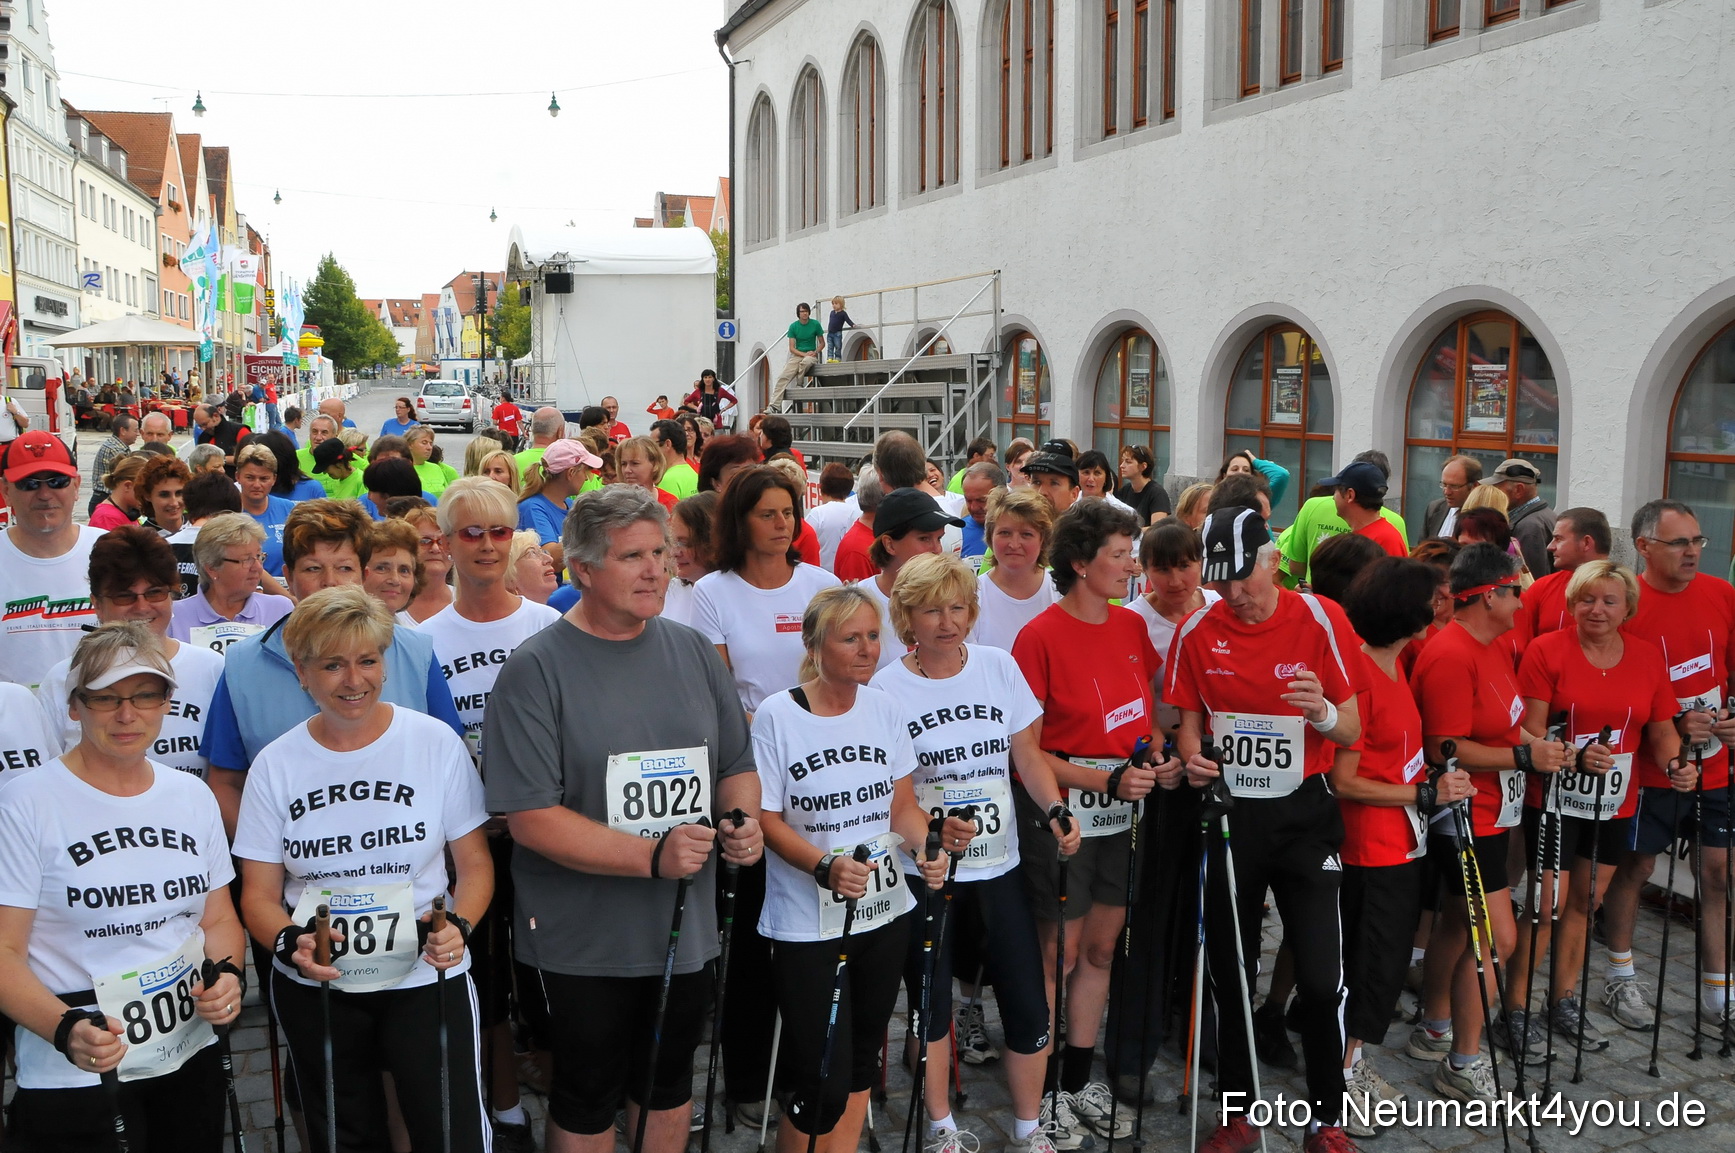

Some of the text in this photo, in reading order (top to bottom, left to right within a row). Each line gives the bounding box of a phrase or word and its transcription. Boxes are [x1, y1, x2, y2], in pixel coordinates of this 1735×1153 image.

[265, 289, 275, 337] HOTEL
[1682, 661, 1699, 674] DEHN
[907, 703, 1004, 739] BERGER
[1114, 707, 1134, 723] DEHN
[1235, 719, 1273, 730] BOCK
[788, 744, 887, 782] BERGER
[916, 745, 968, 768] OWER
[1222, 734, 1293, 769] 8055
[641, 756, 686, 771] BOCK
[1235, 773, 1271, 789] Horst
[288, 780, 415, 822] BERGER
[622, 775, 703, 821] 8022
[790, 790, 851, 813] POWER
[943, 788, 983, 800] BOCK
[804, 822, 841, 834] walking
[843, 815, 860, 829] and
[1092, 813, 1127, 828] Sabine
[67, 826, 199, 868] BERGER
[282, 821, 426, 860] POWER GIRLS
[343, 865, 366, 879] and
[370, 862, 411, 875] talking
[67, 883, 158, 910] POWER
[330, 893, 375, 907] BOCK
[84, 921, 143, 939] walking
[139, 955, 186, 988] BOCK
